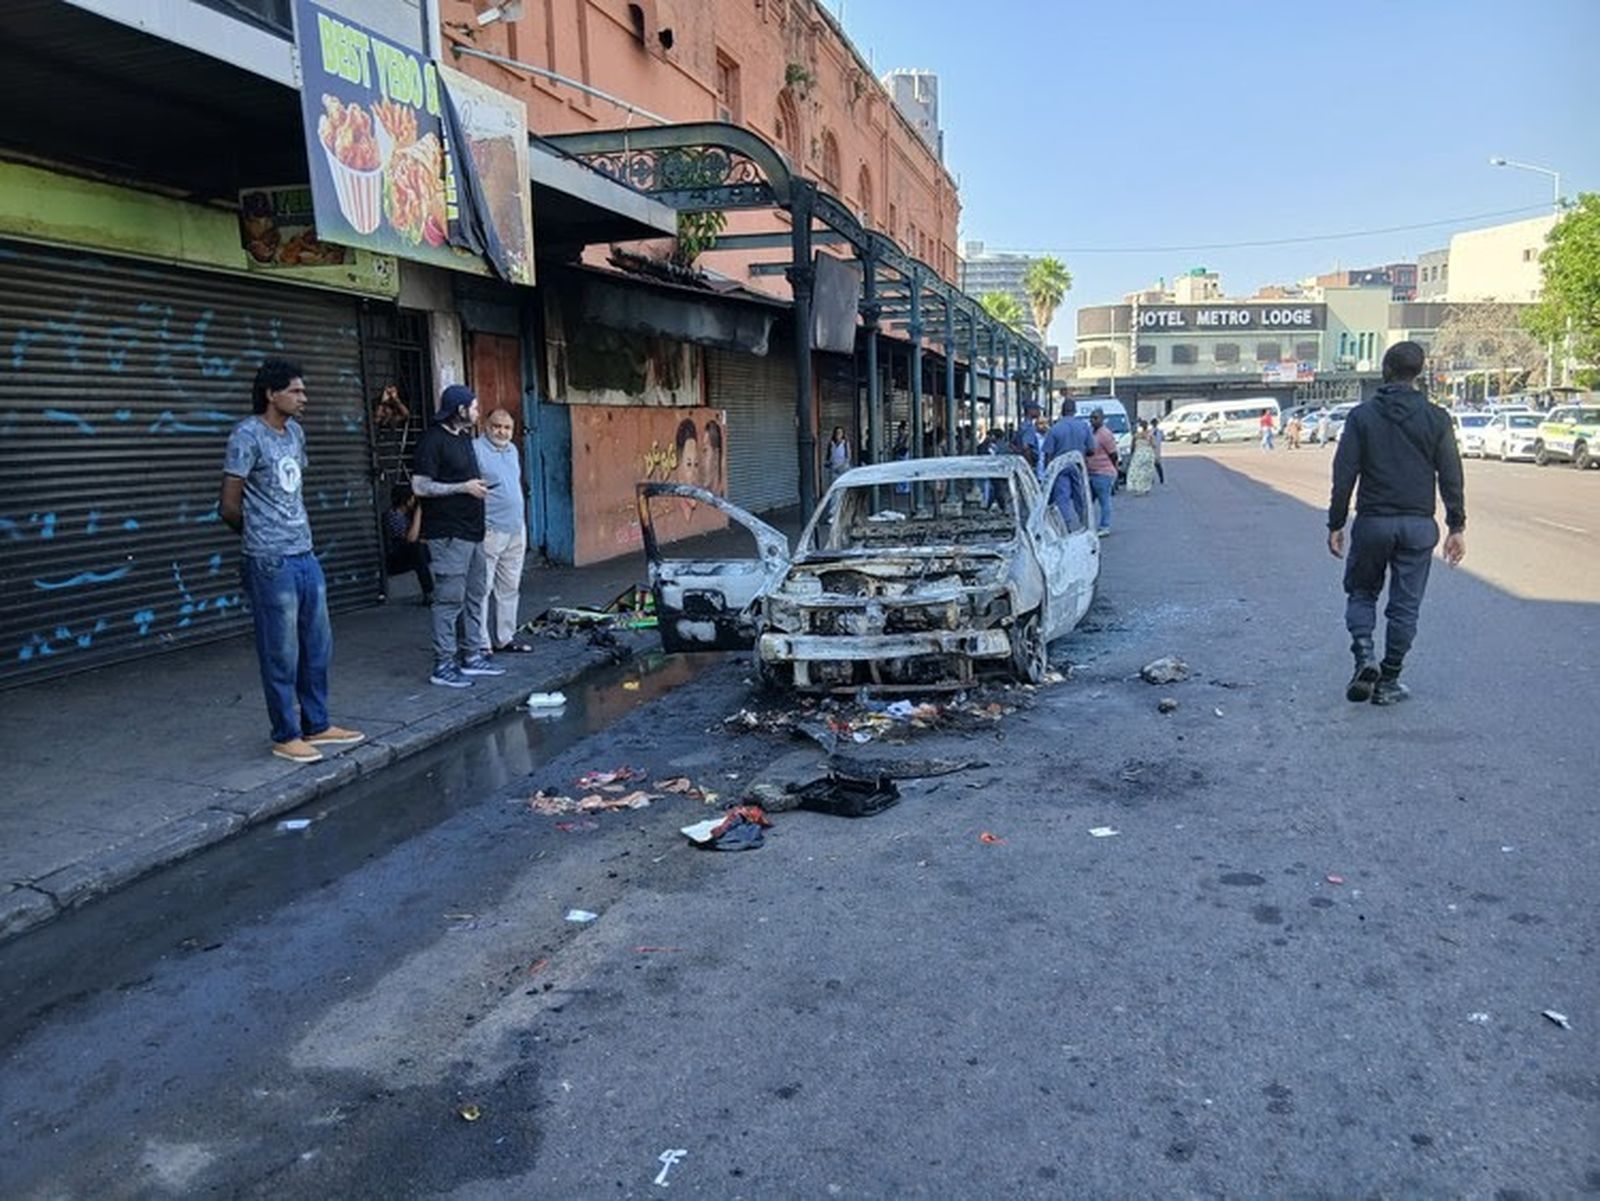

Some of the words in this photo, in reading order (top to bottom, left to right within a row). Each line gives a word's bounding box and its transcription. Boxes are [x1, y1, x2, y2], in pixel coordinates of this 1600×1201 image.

[317, 12, 370, 88] BEST
[371, 38, 423, 109] YEBO
[1197, 310, 1250, 325] METRO
[1262, 309, 1312, 324] LODGE
